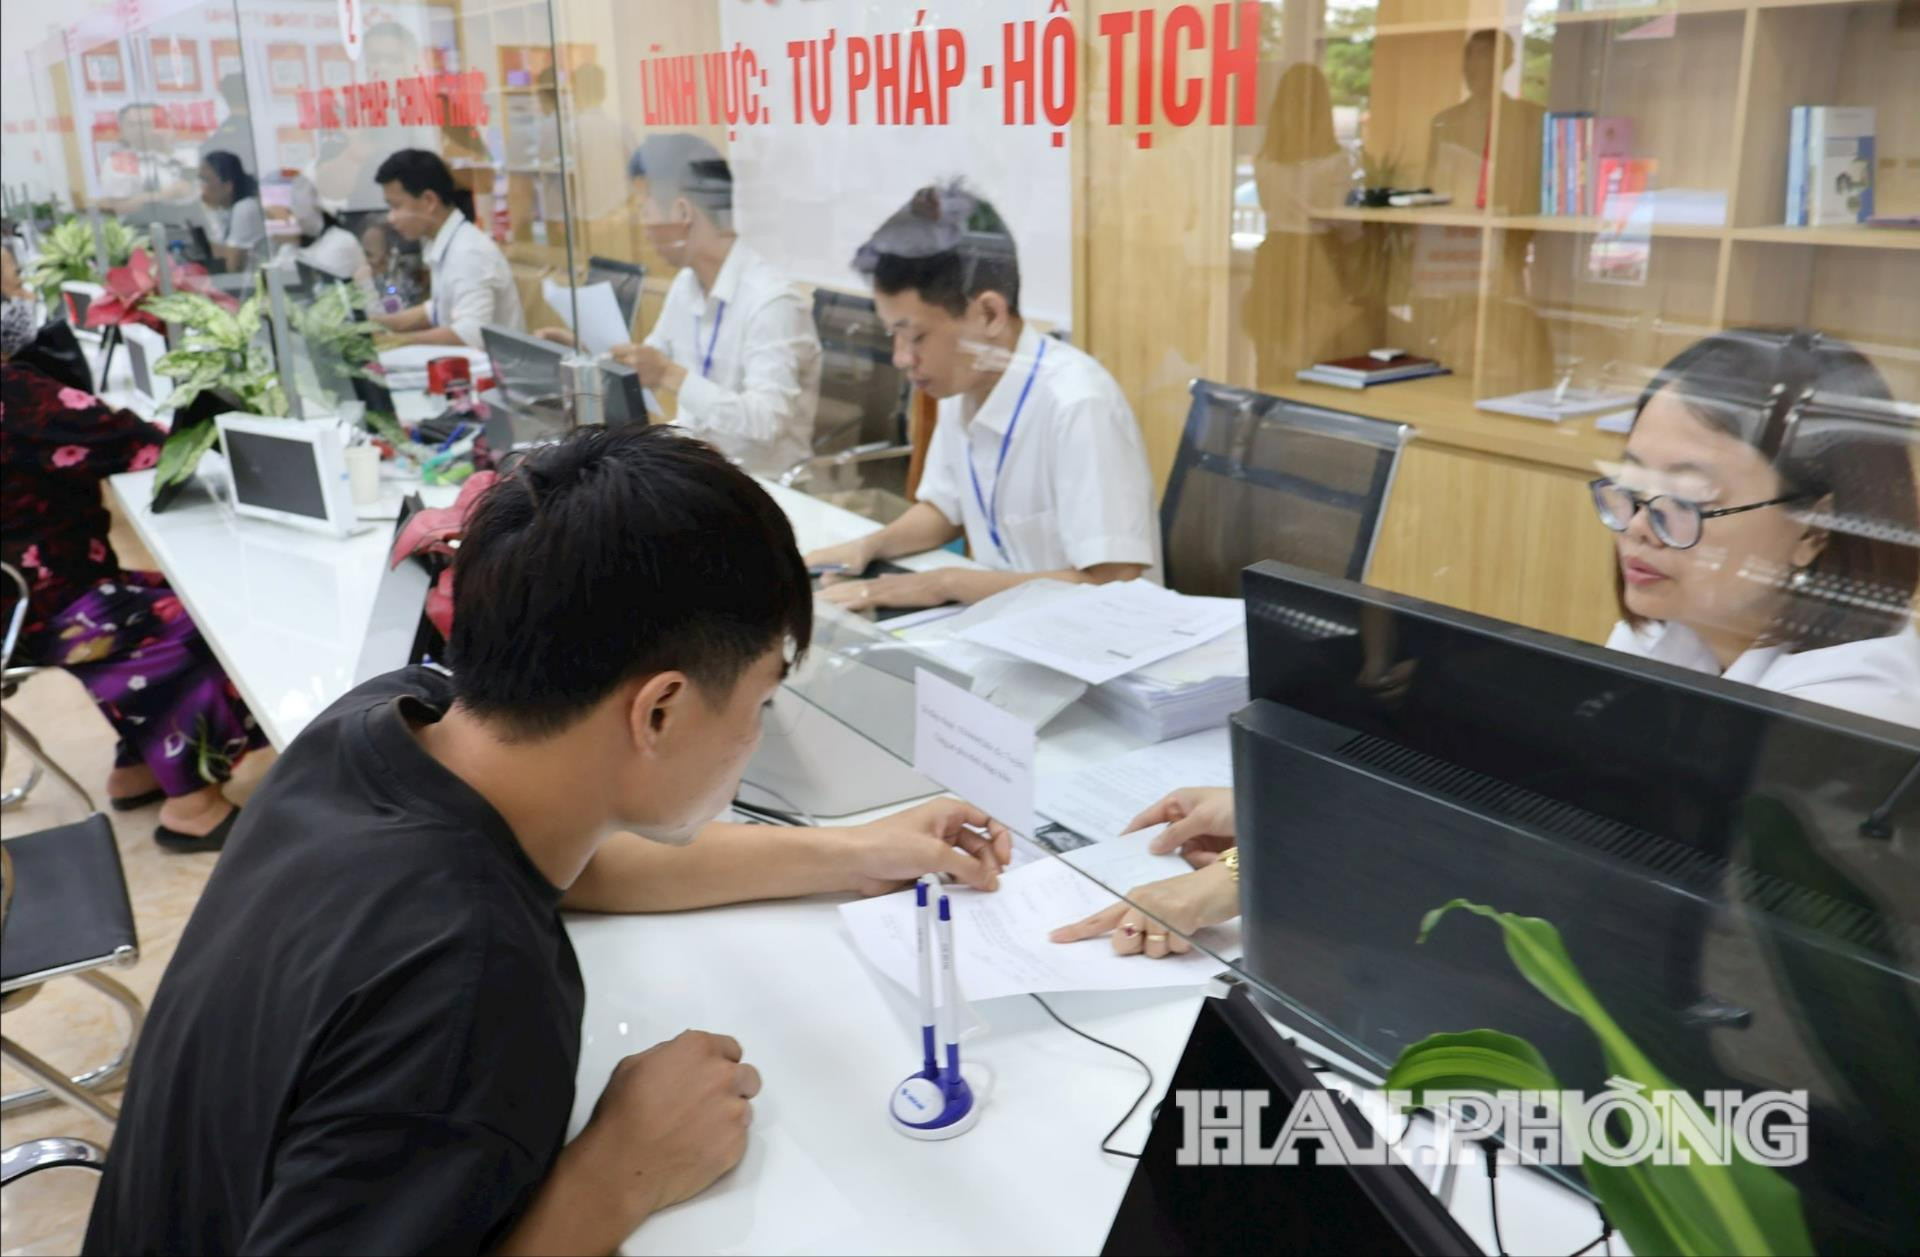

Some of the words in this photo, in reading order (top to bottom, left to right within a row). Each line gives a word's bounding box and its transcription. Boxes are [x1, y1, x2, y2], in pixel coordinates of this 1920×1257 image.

[640, 44, 698, 125] LĨNH
[702, 42, 768, 141] VỰC:
[787, 28, 836, 125] TƯ
[846, 9, 966, 125] PHÁP
[1098, 1, 1260, 149] TỊCH
